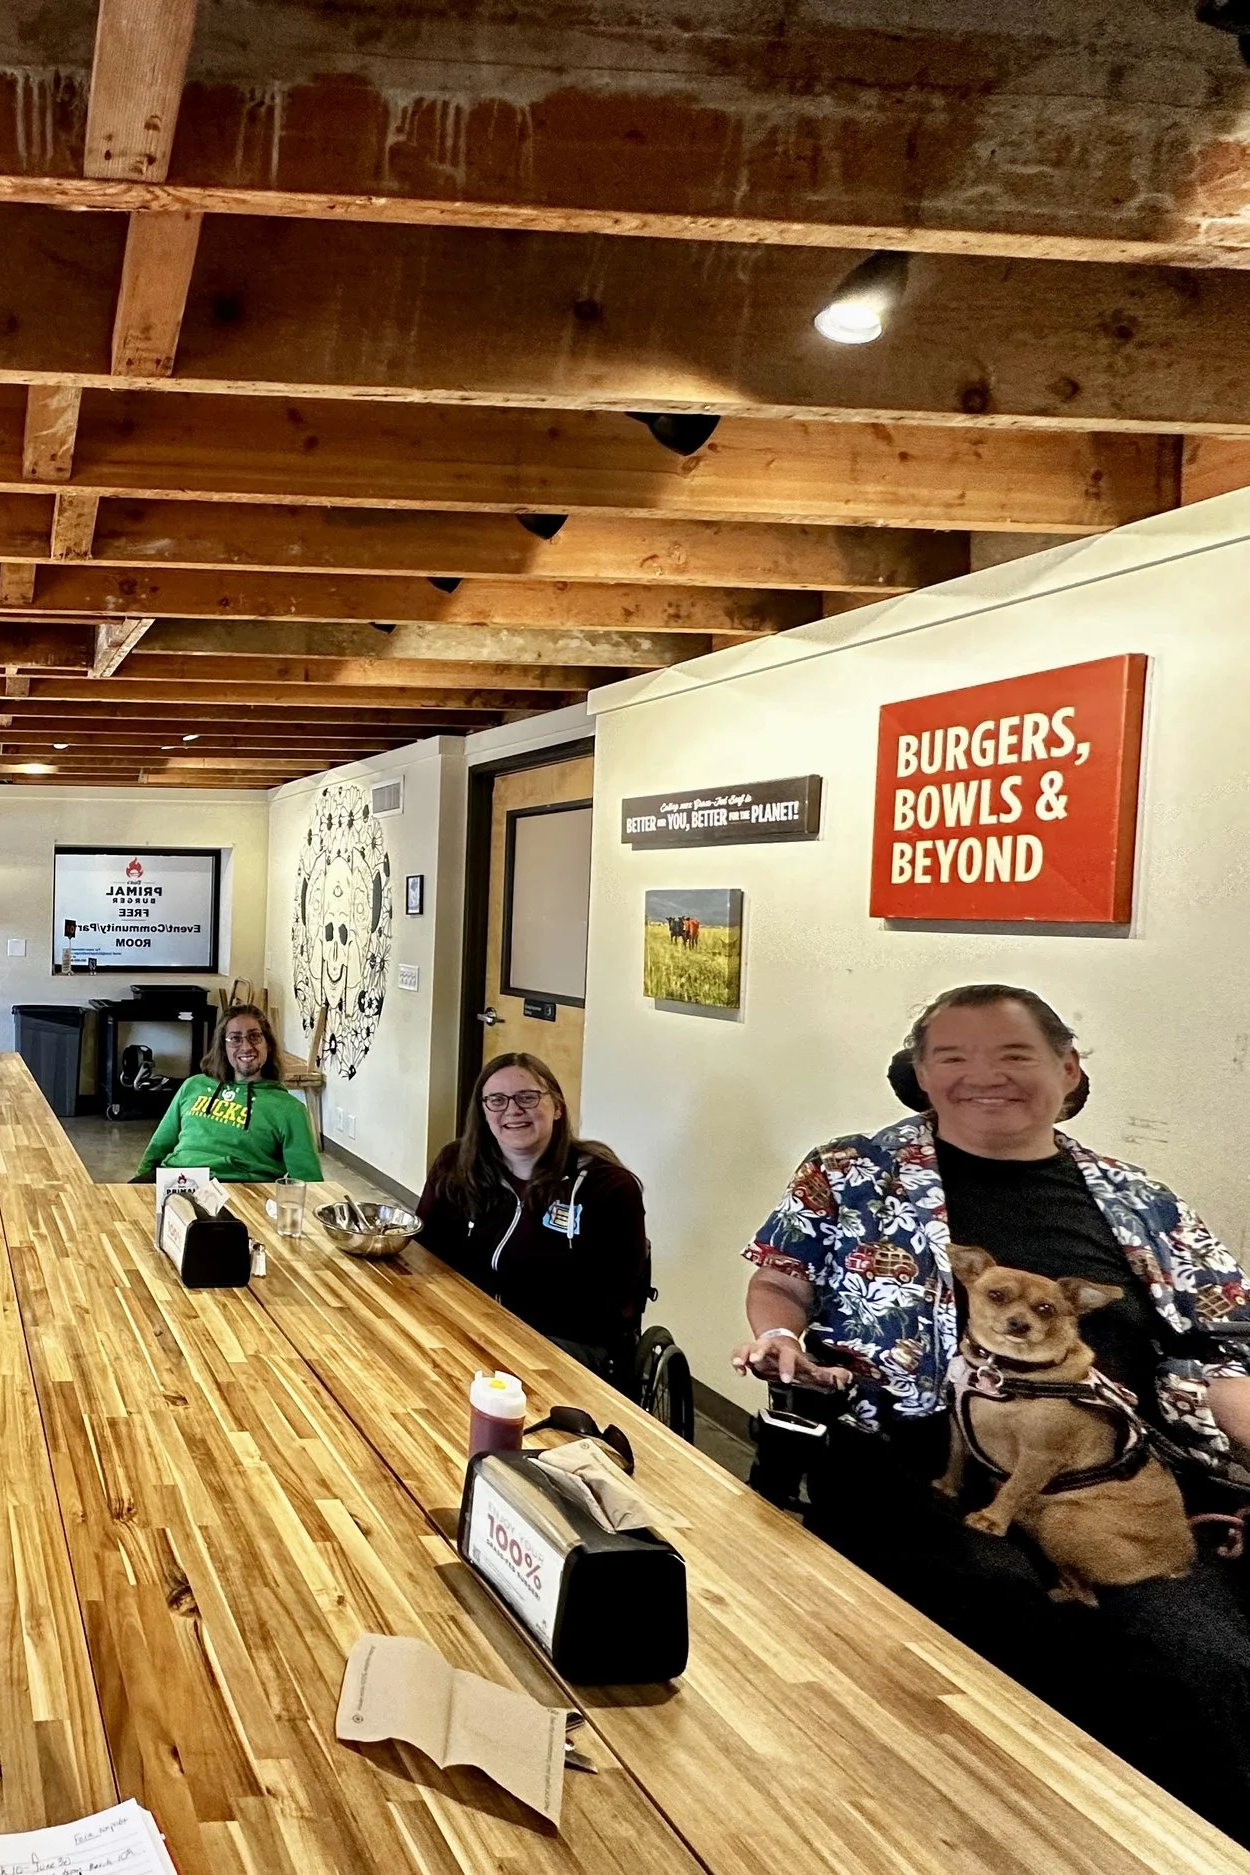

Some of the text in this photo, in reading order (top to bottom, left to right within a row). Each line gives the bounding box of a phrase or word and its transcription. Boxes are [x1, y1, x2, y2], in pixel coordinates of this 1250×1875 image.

[897, 706, 1091, 778] BURGERS,
[626, 815, 657, 833] BETTER
[667, 813, 690, 831] YOU,
[691, 809, 728, 828] BETTER
[729, 812, 739, 820] FOR
[739, 810, 750, 820] THE
[751, 801, 799, 823] PLANET!
[893, 770, 1068, 831] BOWLS &
[890, 834, 1043, 884] BEYOND
[191, 1096, 248, 1124] DUCKS
[488, 1513, 543, 1590] 100%
